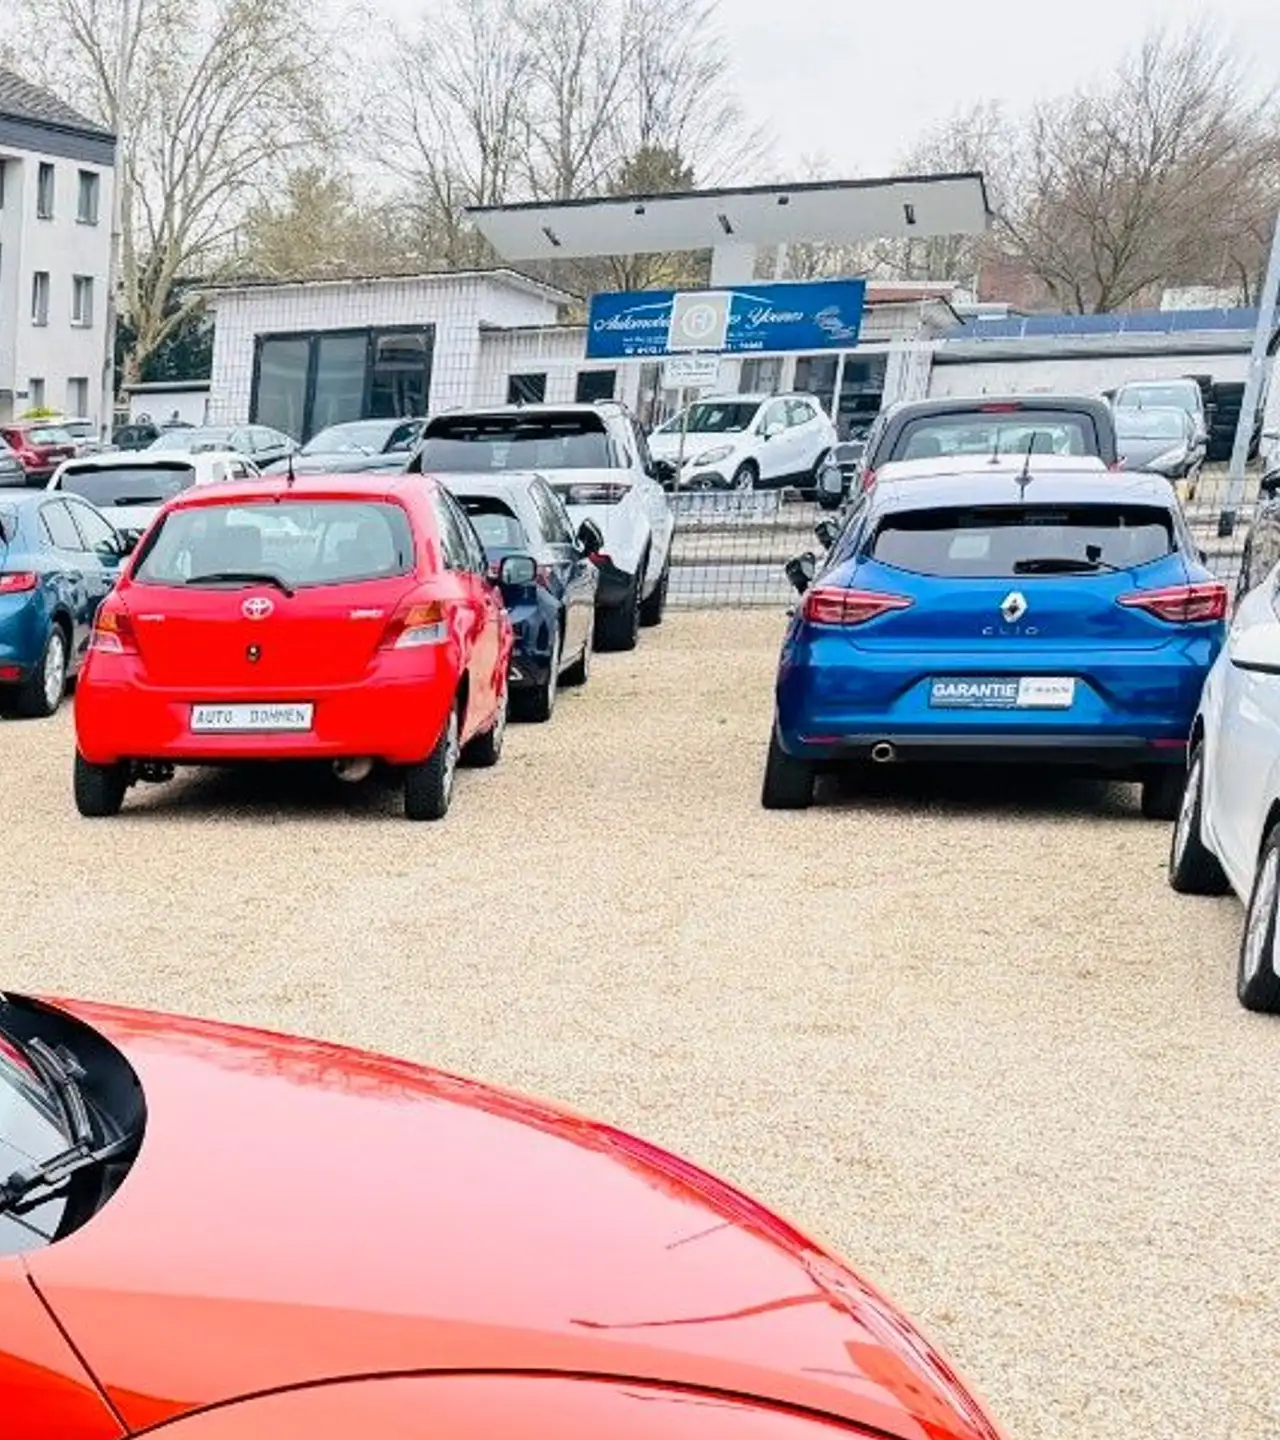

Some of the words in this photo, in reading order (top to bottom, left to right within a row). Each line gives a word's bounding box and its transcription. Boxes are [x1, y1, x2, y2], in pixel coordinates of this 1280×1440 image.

[982, 626, 1039, 635] CLIO
[932, 683, 1017, 697] GARANTIE
[195, 710, 233, 724] AUTO
